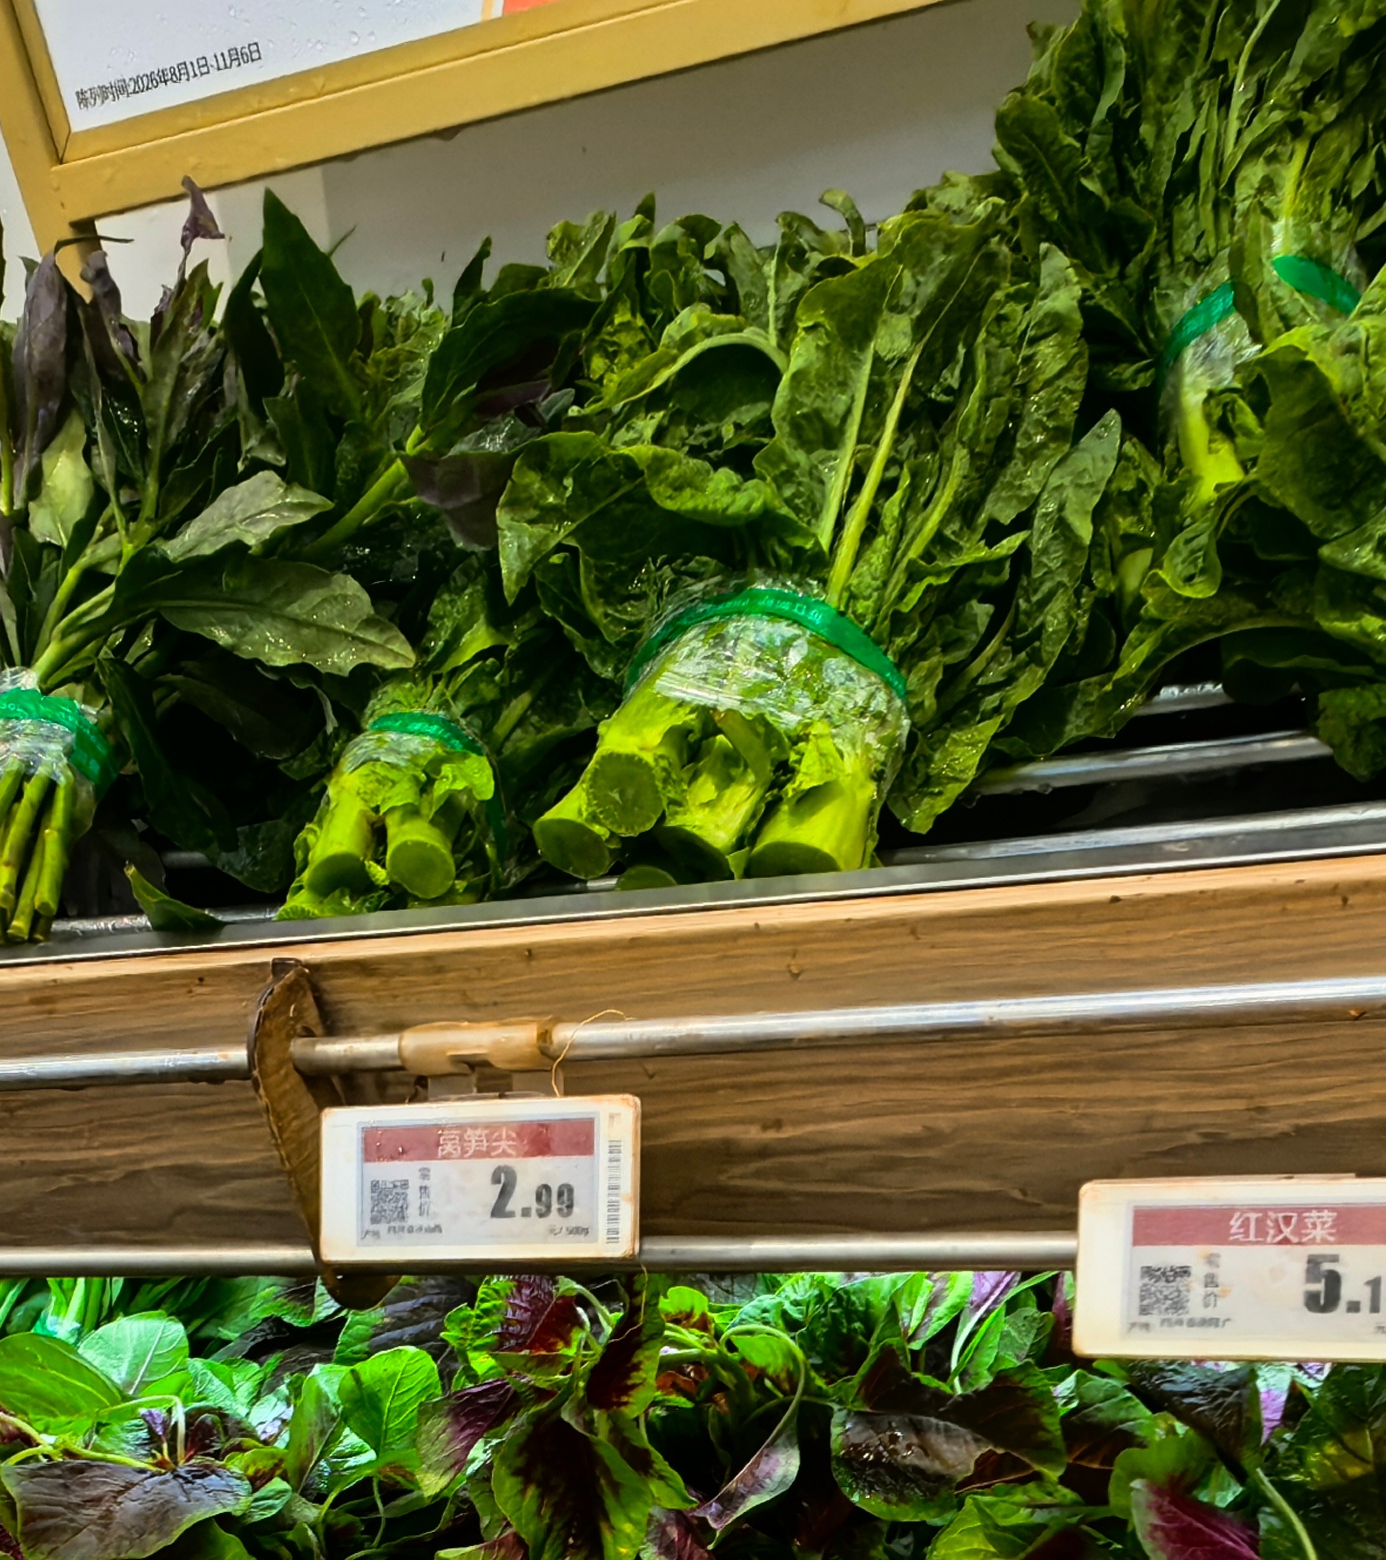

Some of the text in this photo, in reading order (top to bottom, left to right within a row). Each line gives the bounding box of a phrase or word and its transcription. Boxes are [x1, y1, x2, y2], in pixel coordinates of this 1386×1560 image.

[490, 1164, 575, 1220] 2.99
[1228, 1210, 1338, 1244] 红汉菜
